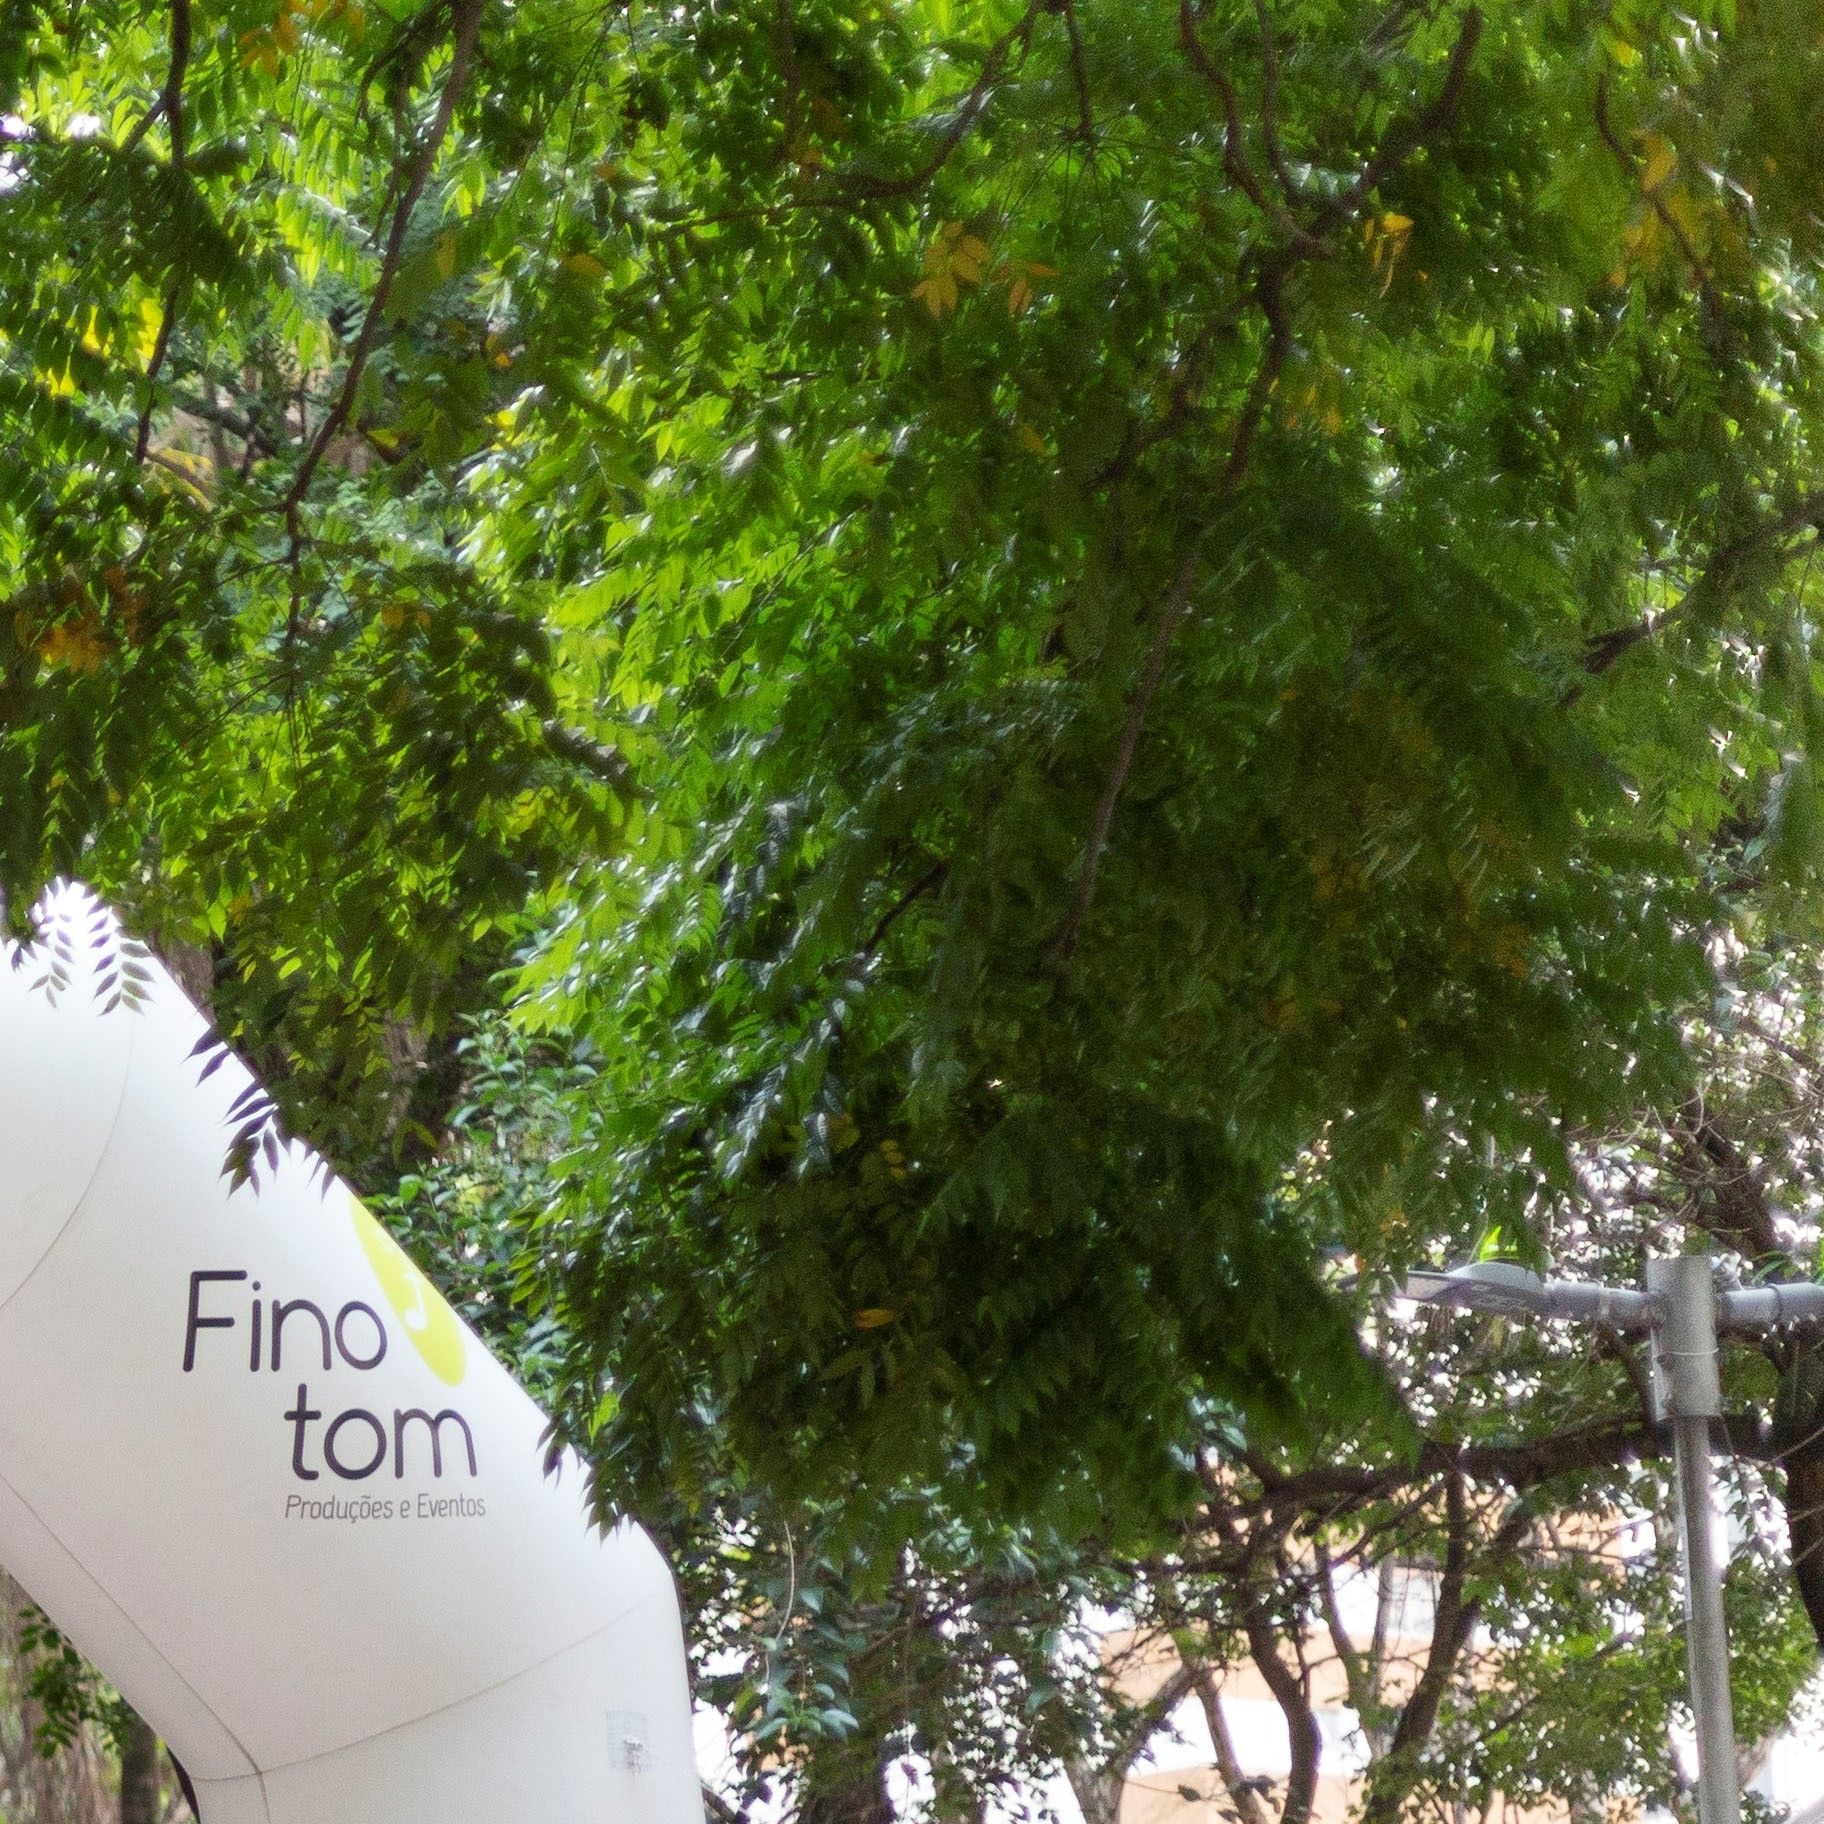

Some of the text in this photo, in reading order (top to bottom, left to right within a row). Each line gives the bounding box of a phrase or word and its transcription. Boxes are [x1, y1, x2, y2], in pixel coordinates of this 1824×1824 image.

[183, 1270, 387, 1373] Fino
[284, 1383, 478, 1480] tom
[284, 1493, 486, 1524] Produções e Eventos
